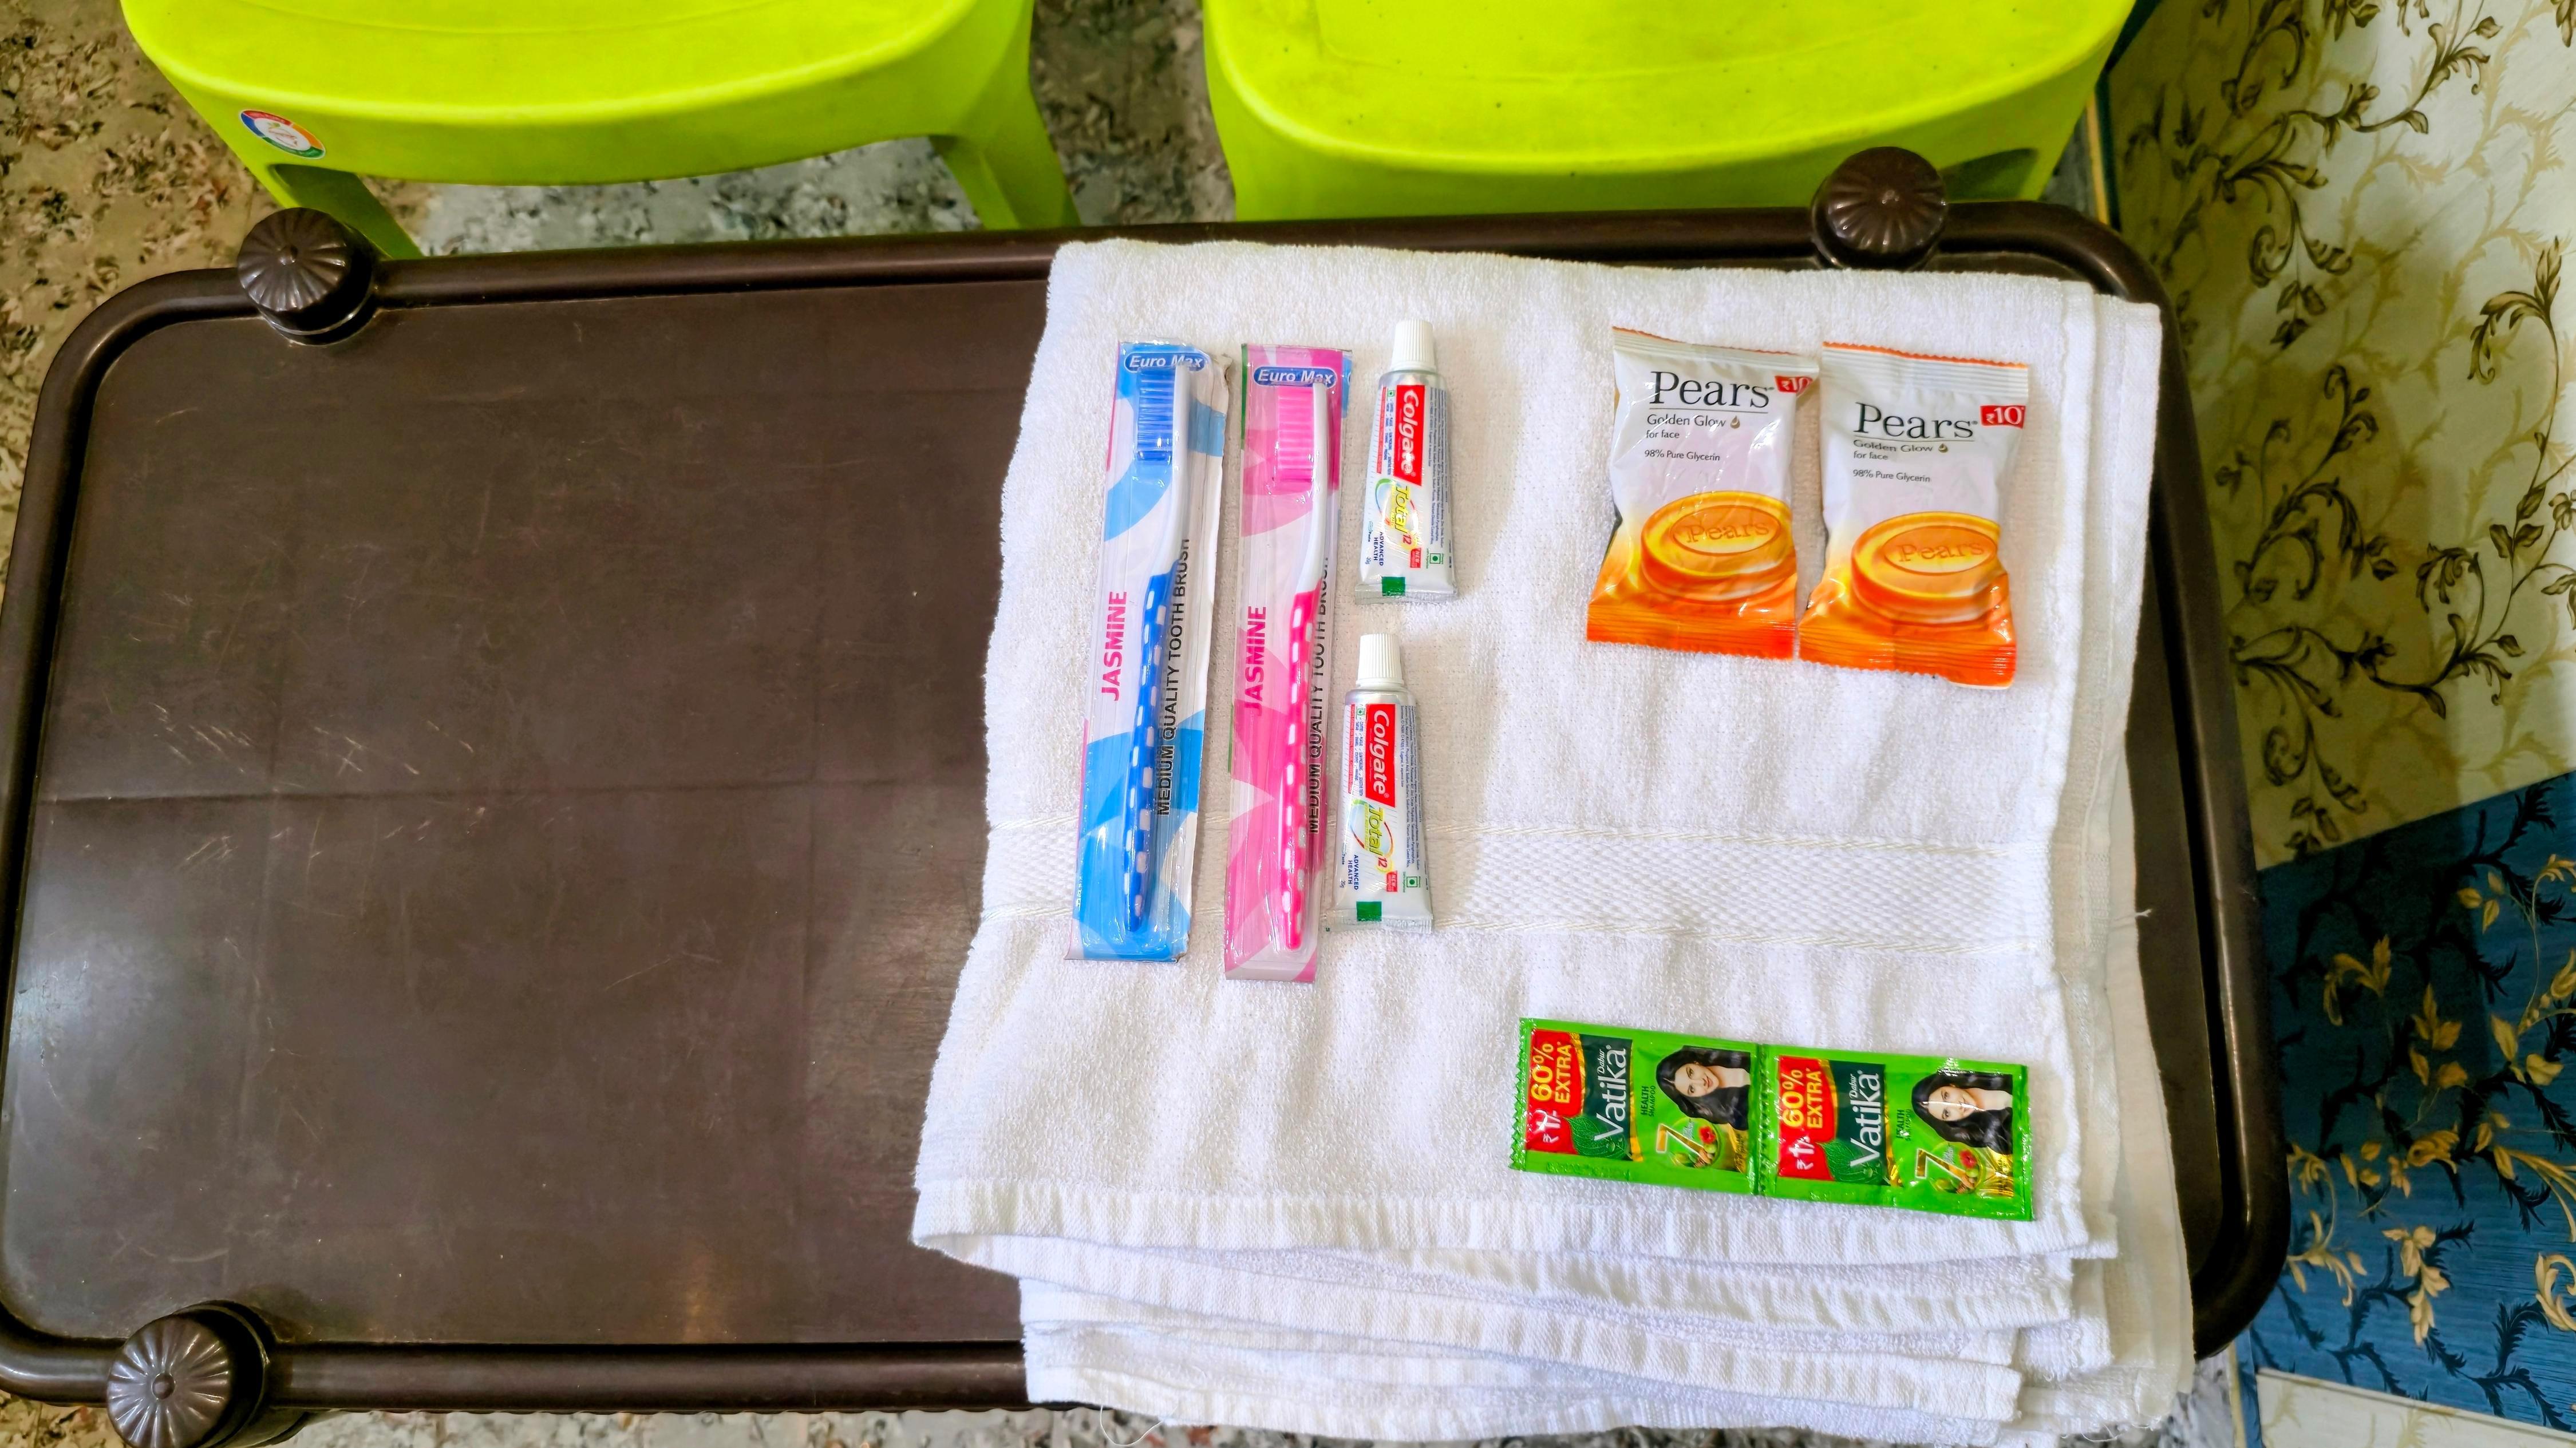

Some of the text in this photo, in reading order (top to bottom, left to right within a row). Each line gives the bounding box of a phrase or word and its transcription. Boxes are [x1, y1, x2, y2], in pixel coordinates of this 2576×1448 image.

[1129, 355, 1166, 368] Euro
[1258, 369, 1333, 384] Euro Max
[1649, 371, 1770, 408] Pears
[1398, 390, 1419, 474] Colgate
[1646, 414, 1726, 427] Golden Glow
[1646, 429, 1680, 439] for face
[1853, 401, 1973, 439] Pears
[1644, 449, 1720, 462] 98% Pure Glycerin
[1853, 439, 1933, 453] Golden Glow
[1853, 451, 1888, 460] for face
[1852, 469, 1930, 482] 98% Pure Glycerin
[1395, 485, 1410, 534] Total
[1402, 534, 1412, 545] 12
[1686, 520, 1771, 543] Pears
[1895, 541, 1985, 561] Pears
[1101, 592, 1127, 701] JASMINE
[1168, 603, 1184, 660] TOOTH
[1244, 606, 1267, 716] JASMINE
[1162, 665, 1180, 739] QUALITY
[1309, 686, 1323, 758] QUALITY
[1369, 710, 1389, 794] Colgate
[1156, 745, 1174, 815] MEDIUM
[1309, 764, 1321, 833] MEDIUM
[1369, 807, 1384, 856] Total
[1378, 857, 1388, 868] 12
[1531, 1044, 1554, 1102] 60%
[1597, 1049, 1605, 1074] Dabur
[1594, 1048, 1626, 1141] Vatika
[1641, 1086, 1649, 1115] HEALTH
[1781, 1069, 1804, 1127] 60%
[1848, 1074, 1858, 1099] Dabur
[1850, 1073, 1882, 1167] Vatika
[1656, 1123, 1704, 1153] 7
[1915, 1148, 1966, 1180] 7
